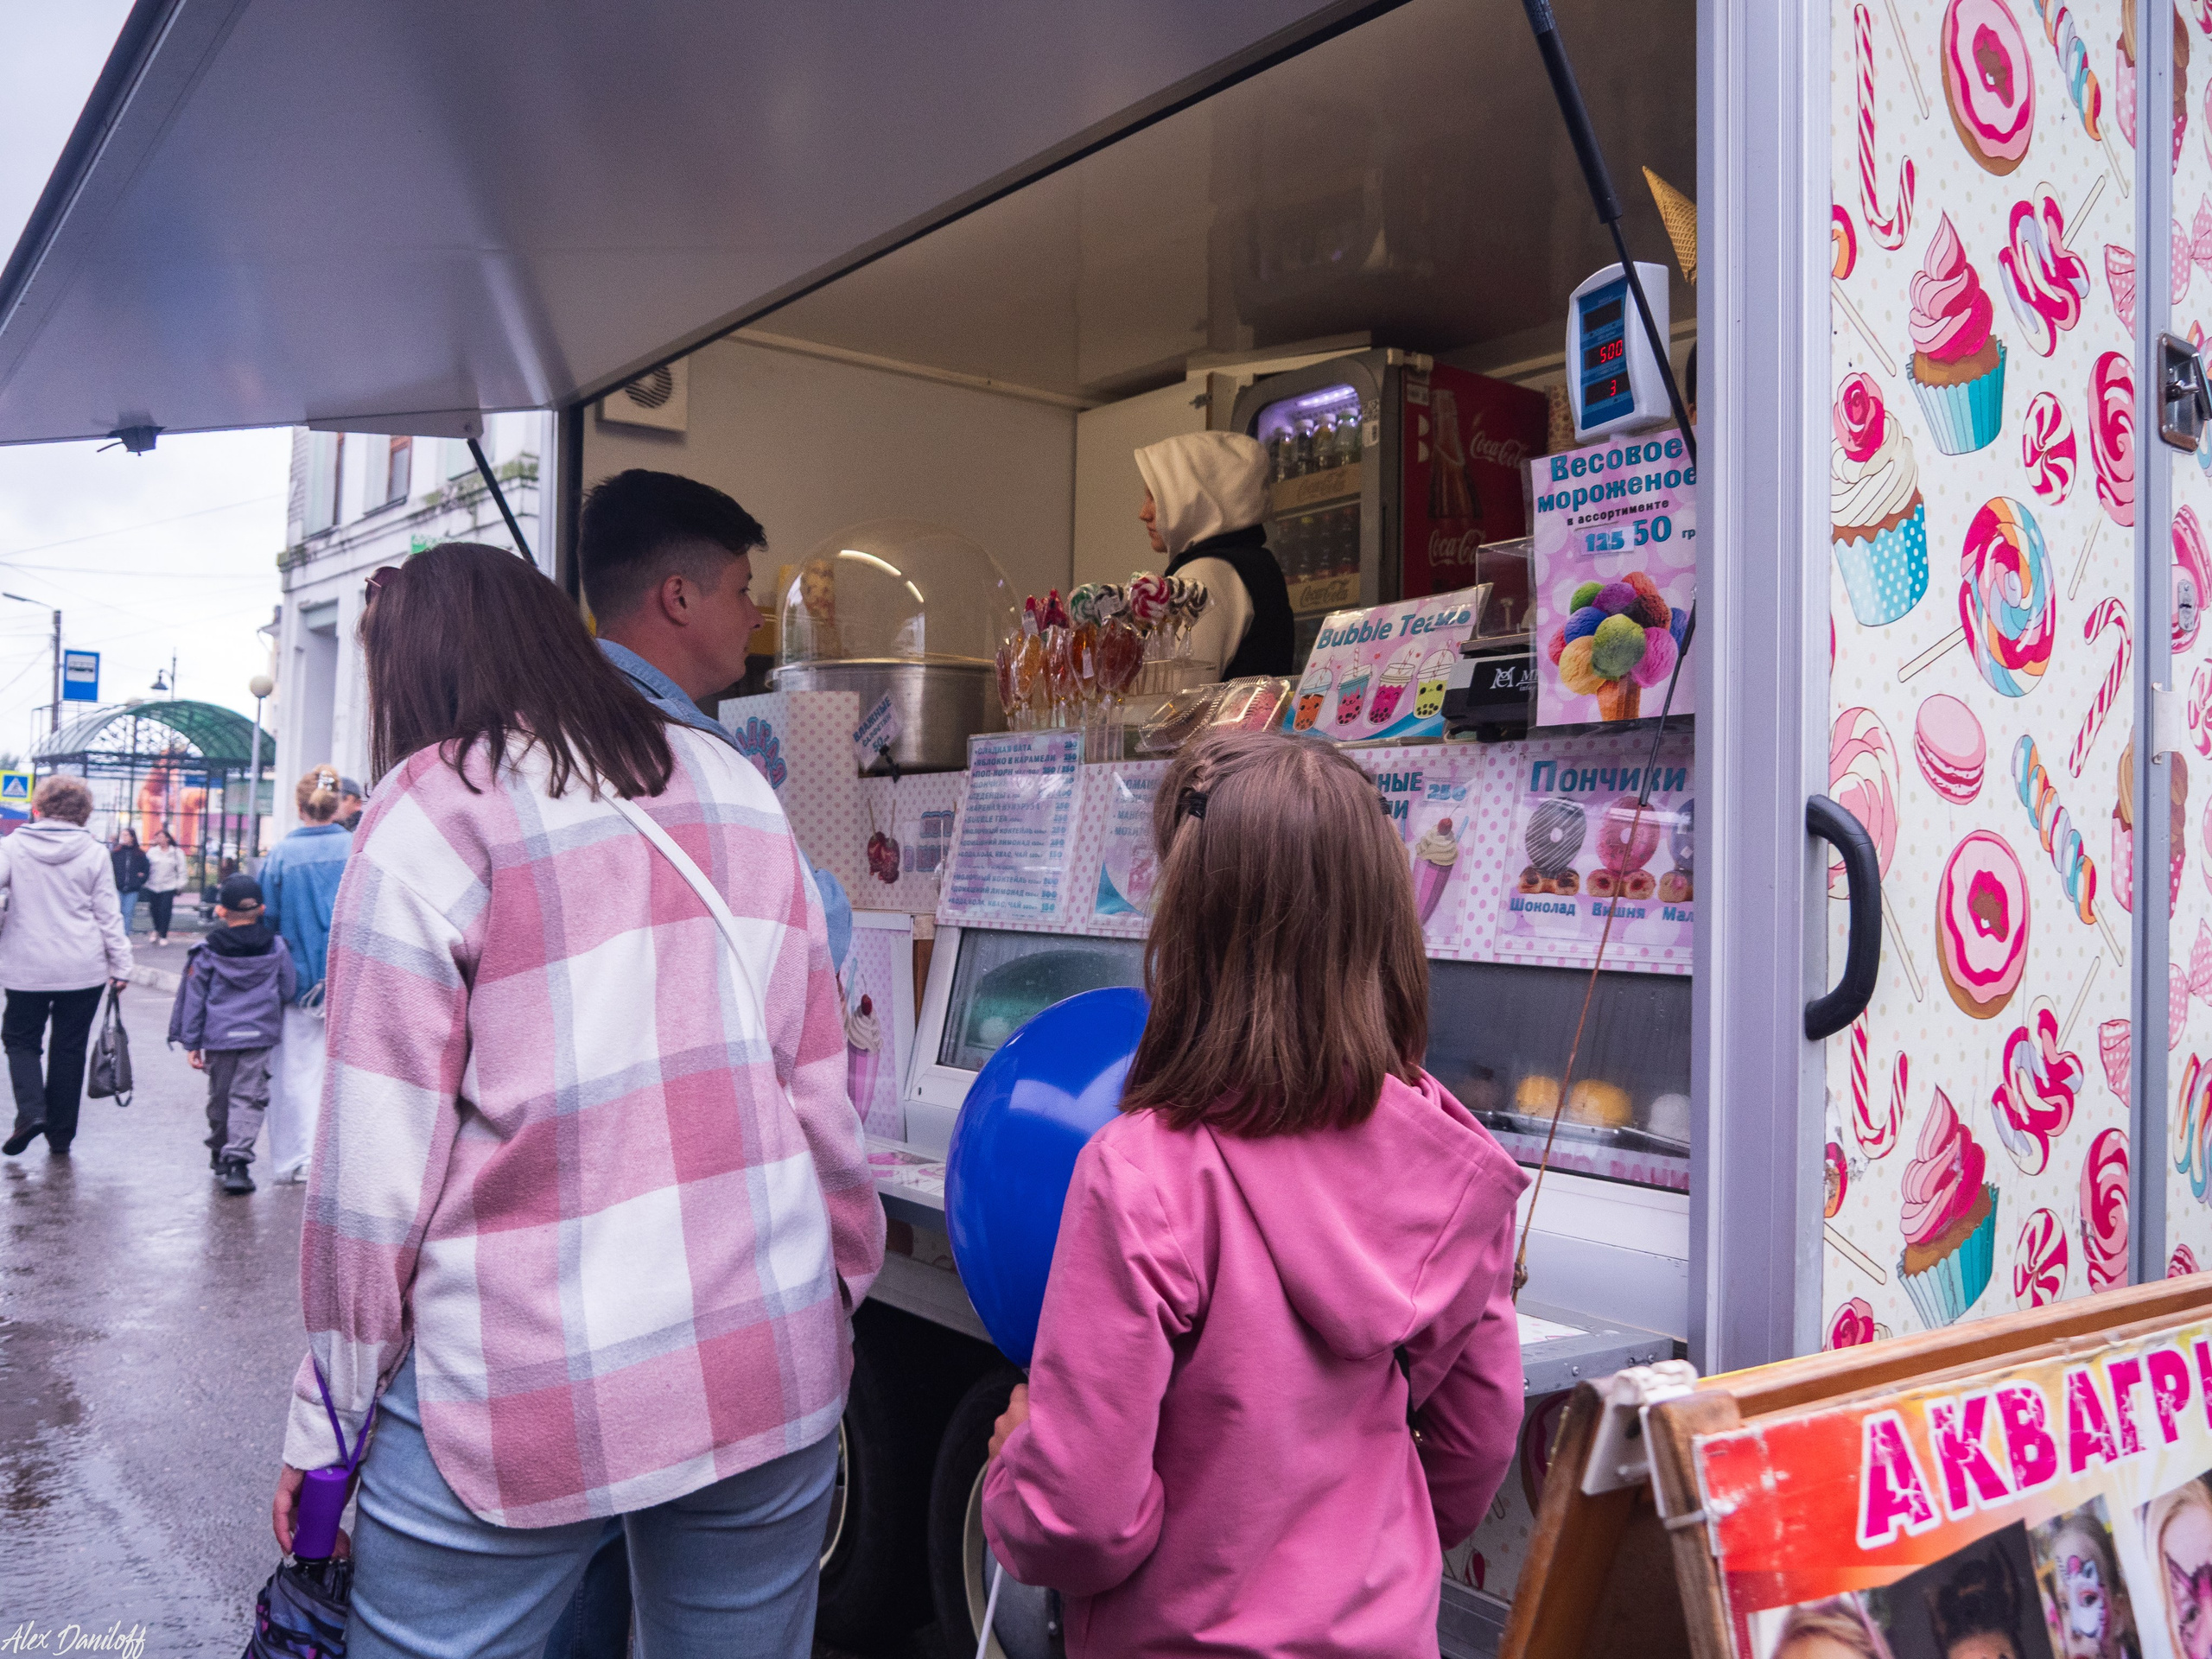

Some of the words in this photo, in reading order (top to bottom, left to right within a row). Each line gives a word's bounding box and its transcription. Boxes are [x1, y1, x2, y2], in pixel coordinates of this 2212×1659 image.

[1599, 340, 1623, 363] 500
[1610, 379, 1617, 397] 3
[1550, 437, 1683, 481] Весовое
[1537, 467, 1696, 513] мороженое
[1567, 518, 1573, 526] в
[1578, 499, 1669, 524] ассортименте
[1585, 531, 1624, 552] 125
[1633, 515, 1672, 546] 50
[1316, 618, 1393, 650] Bubble
[852, 696, 892, 742] ВЛАЖНЫЕ
[1529, 760, 1688, 792] Пончики
[1427, 784, 1467, 802] 250
[1509, 898, 1576, 916] Шоколад
[1591, 902, 1646, 919] Вишня
